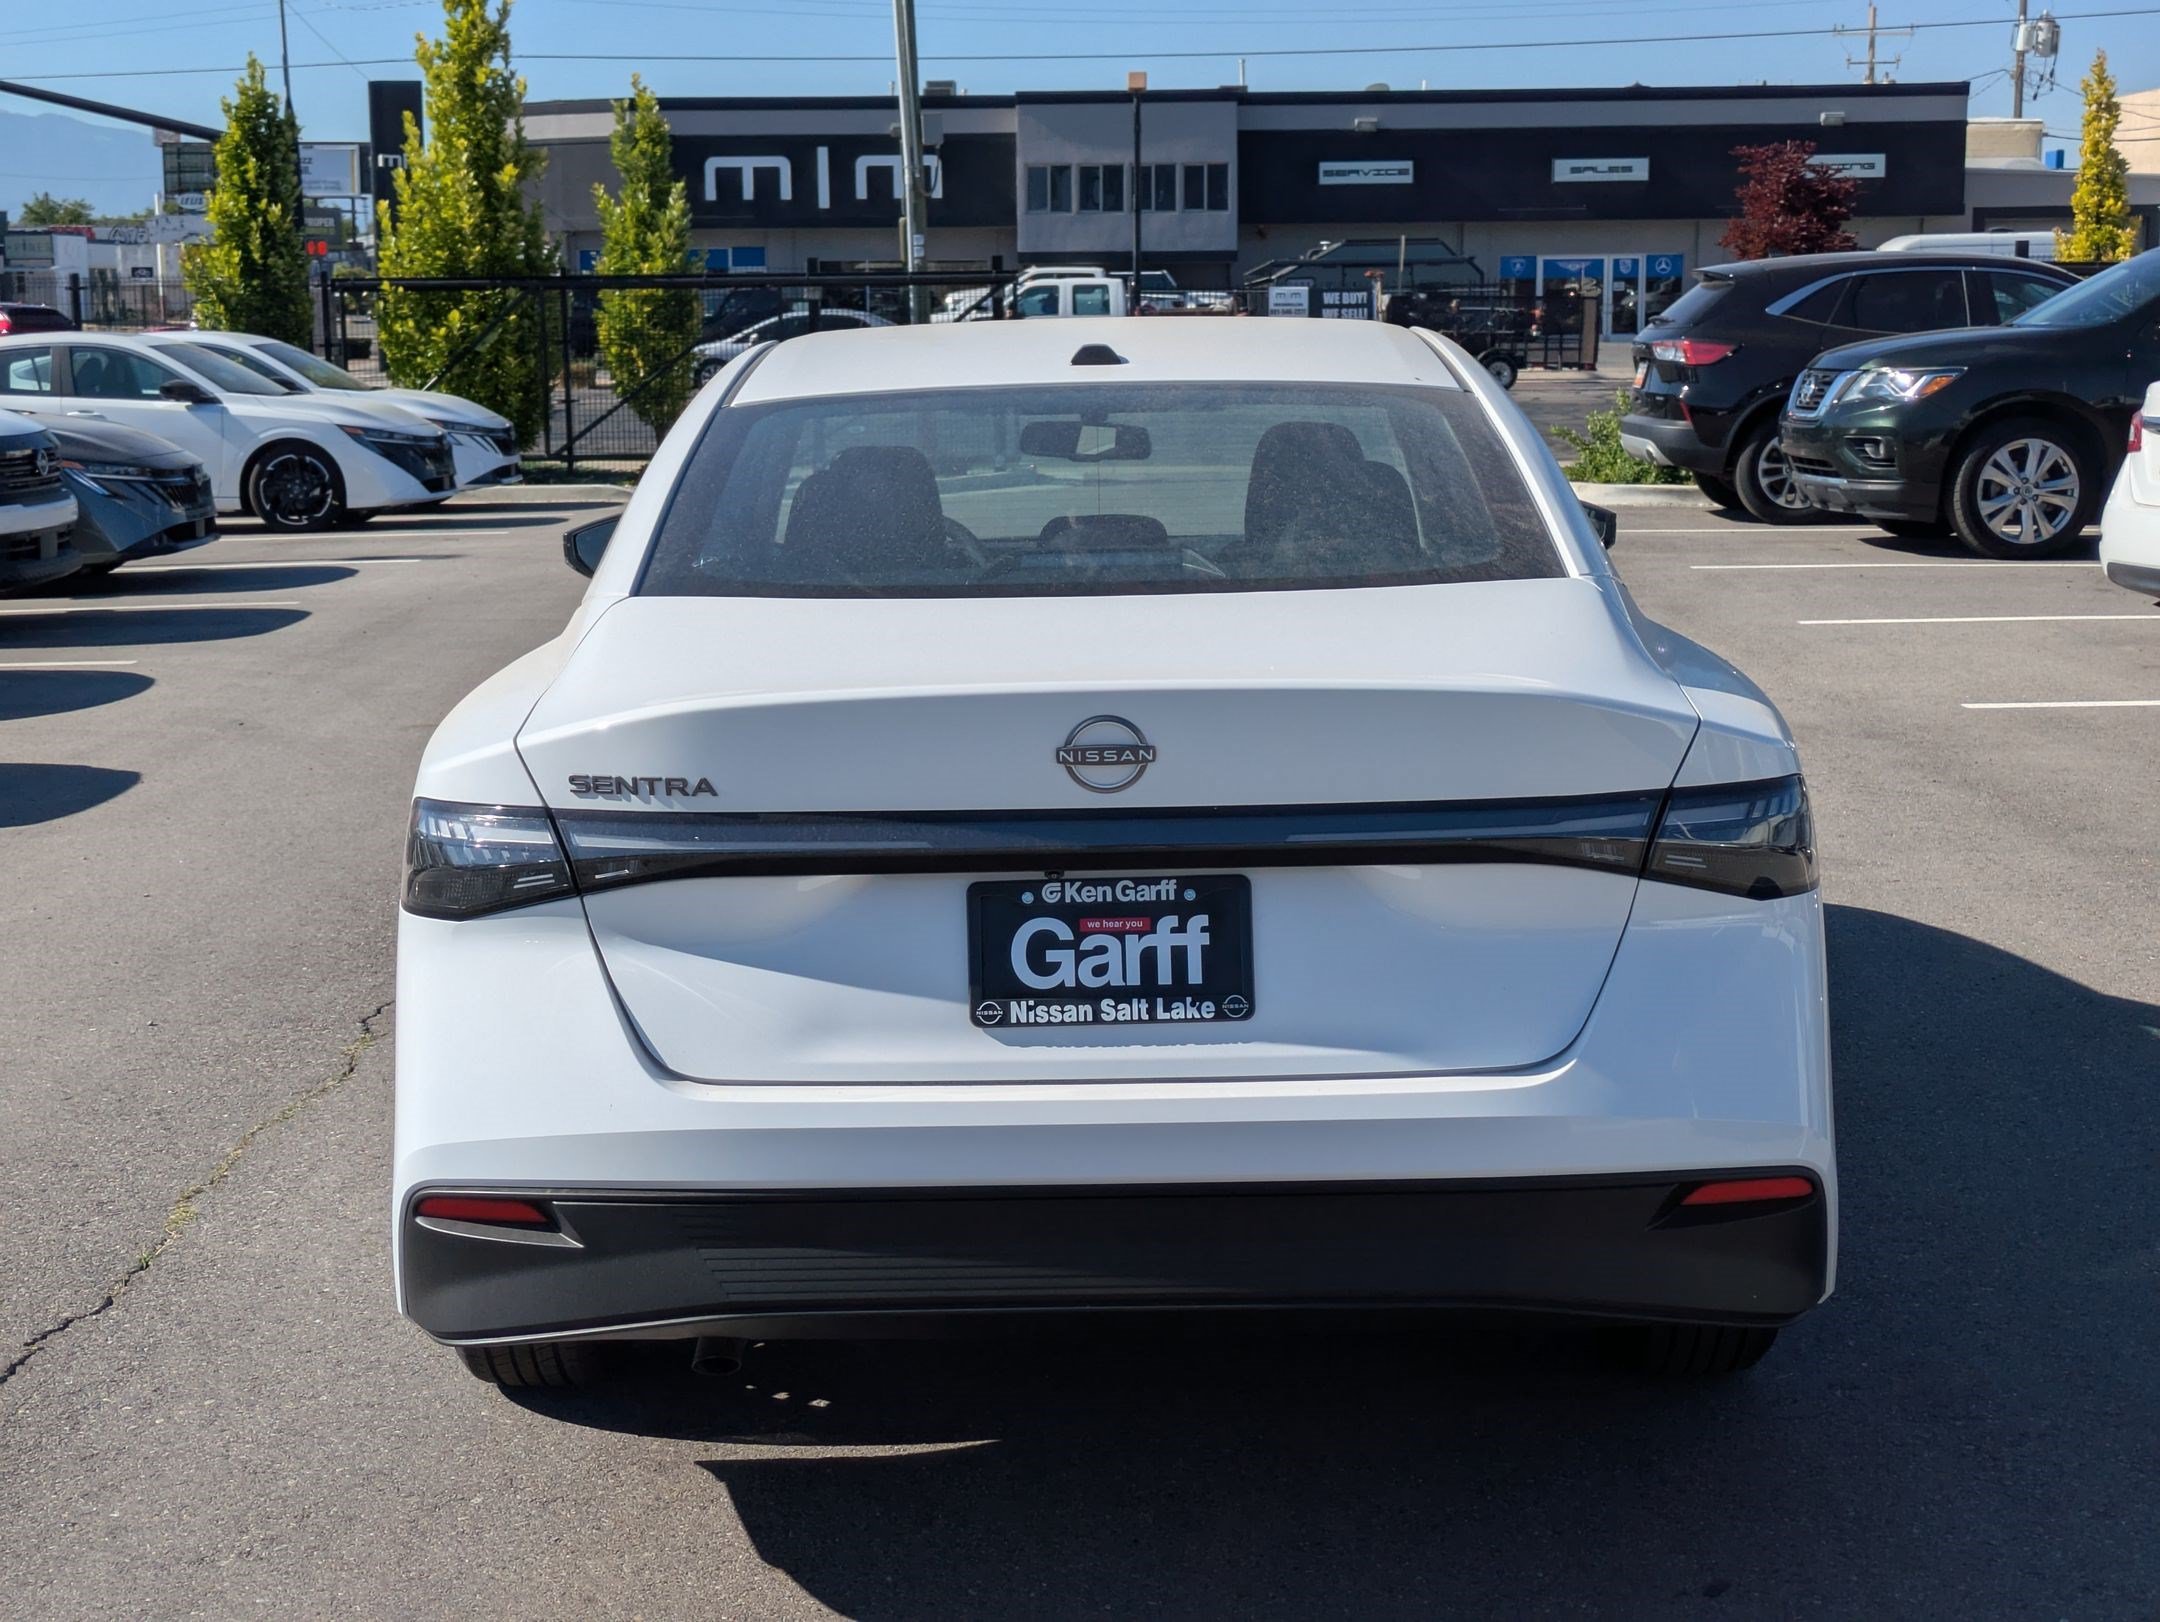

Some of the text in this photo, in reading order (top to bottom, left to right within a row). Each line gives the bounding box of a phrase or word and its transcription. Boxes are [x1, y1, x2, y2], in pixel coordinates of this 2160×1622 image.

[1322, 168, 1410, 177] SERVICE
[1570, 166, 1633, 174] SALES
[1323, 292, 1367, 304] WE BUY!
[1322, 308, 1340, 319] WE
[1060, 750, 1153, 762] NISSAN
[568, 775, 719, 796] SENTRA
[1065, 879, 1177, 902] Ken Garff
[1102, 920, 1123, 928] hear
[1125, 920, 1143, 930] you
[1010, 914, 1210, 990] Garff
[1010, 996, 1216, 1024] Nissan Salt Lake
